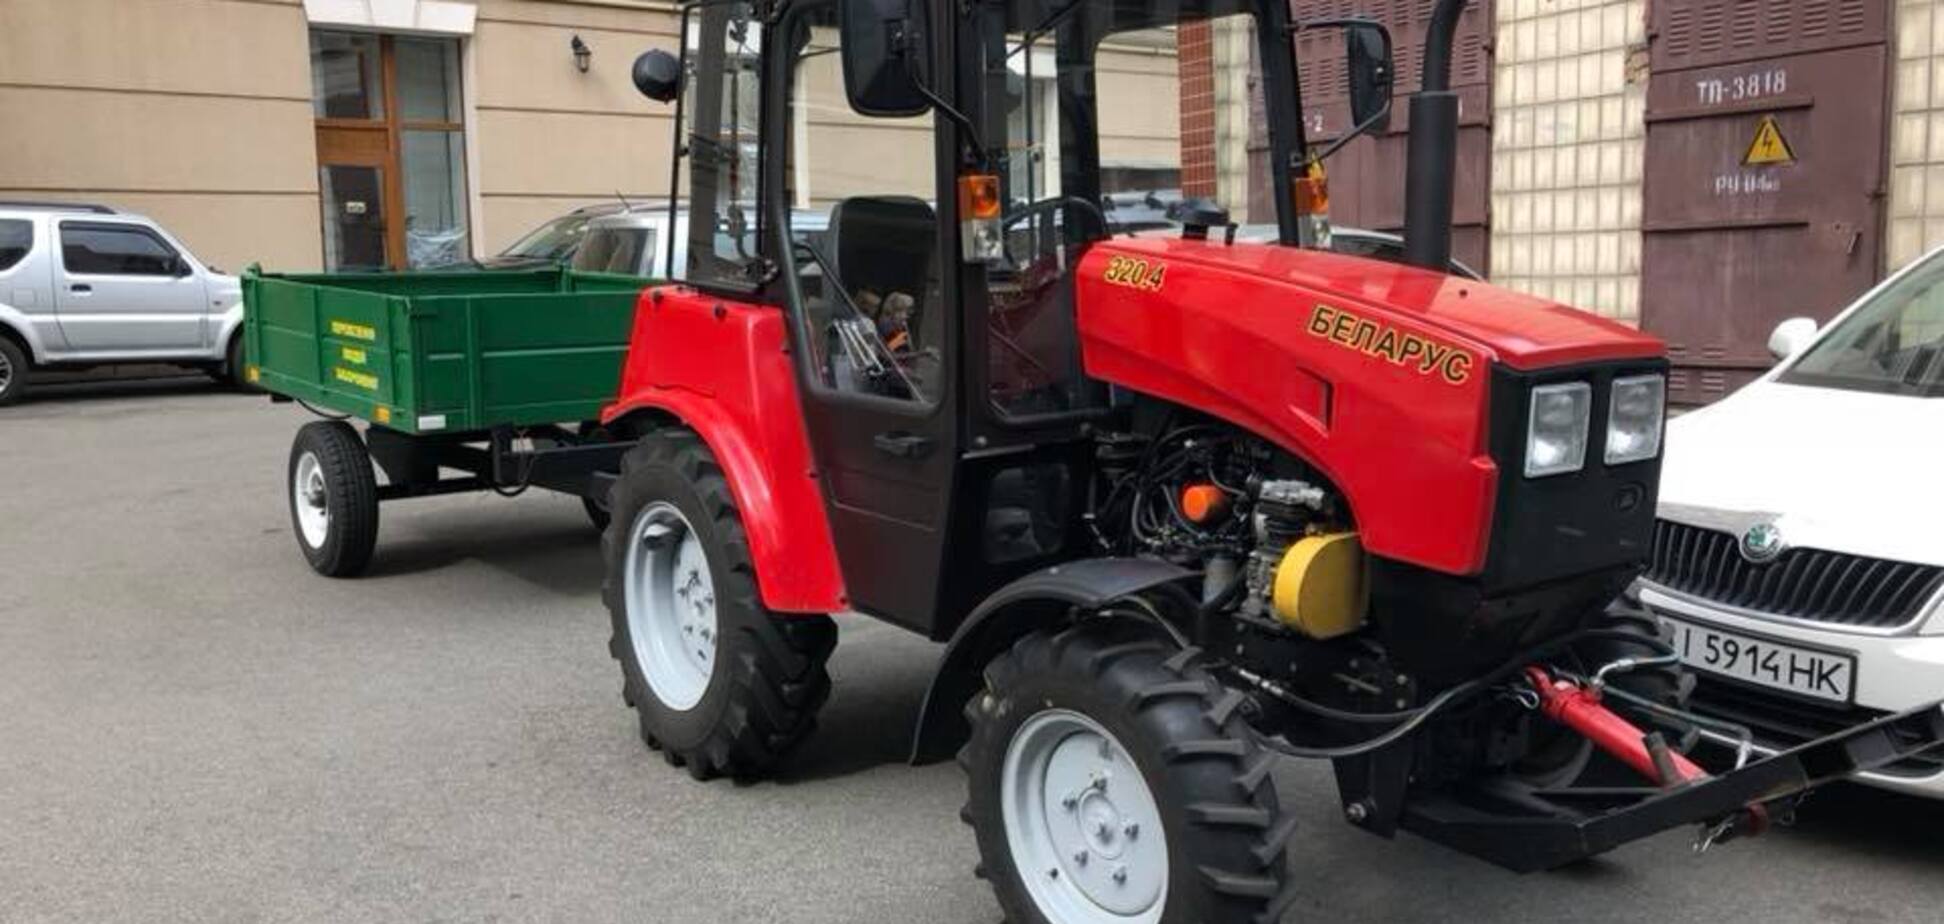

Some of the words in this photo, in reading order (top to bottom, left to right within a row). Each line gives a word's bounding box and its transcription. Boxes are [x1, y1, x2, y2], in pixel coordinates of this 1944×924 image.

[1696, 69, 1786, 104] ТП-3818
[1105, 255, 1166, 292] 320.4
[1309, 304, 1474, 383] БЕЛАРУС
[1704, 634, 1780, 682] 5914
[1788, 652, 1844, 696] HK
